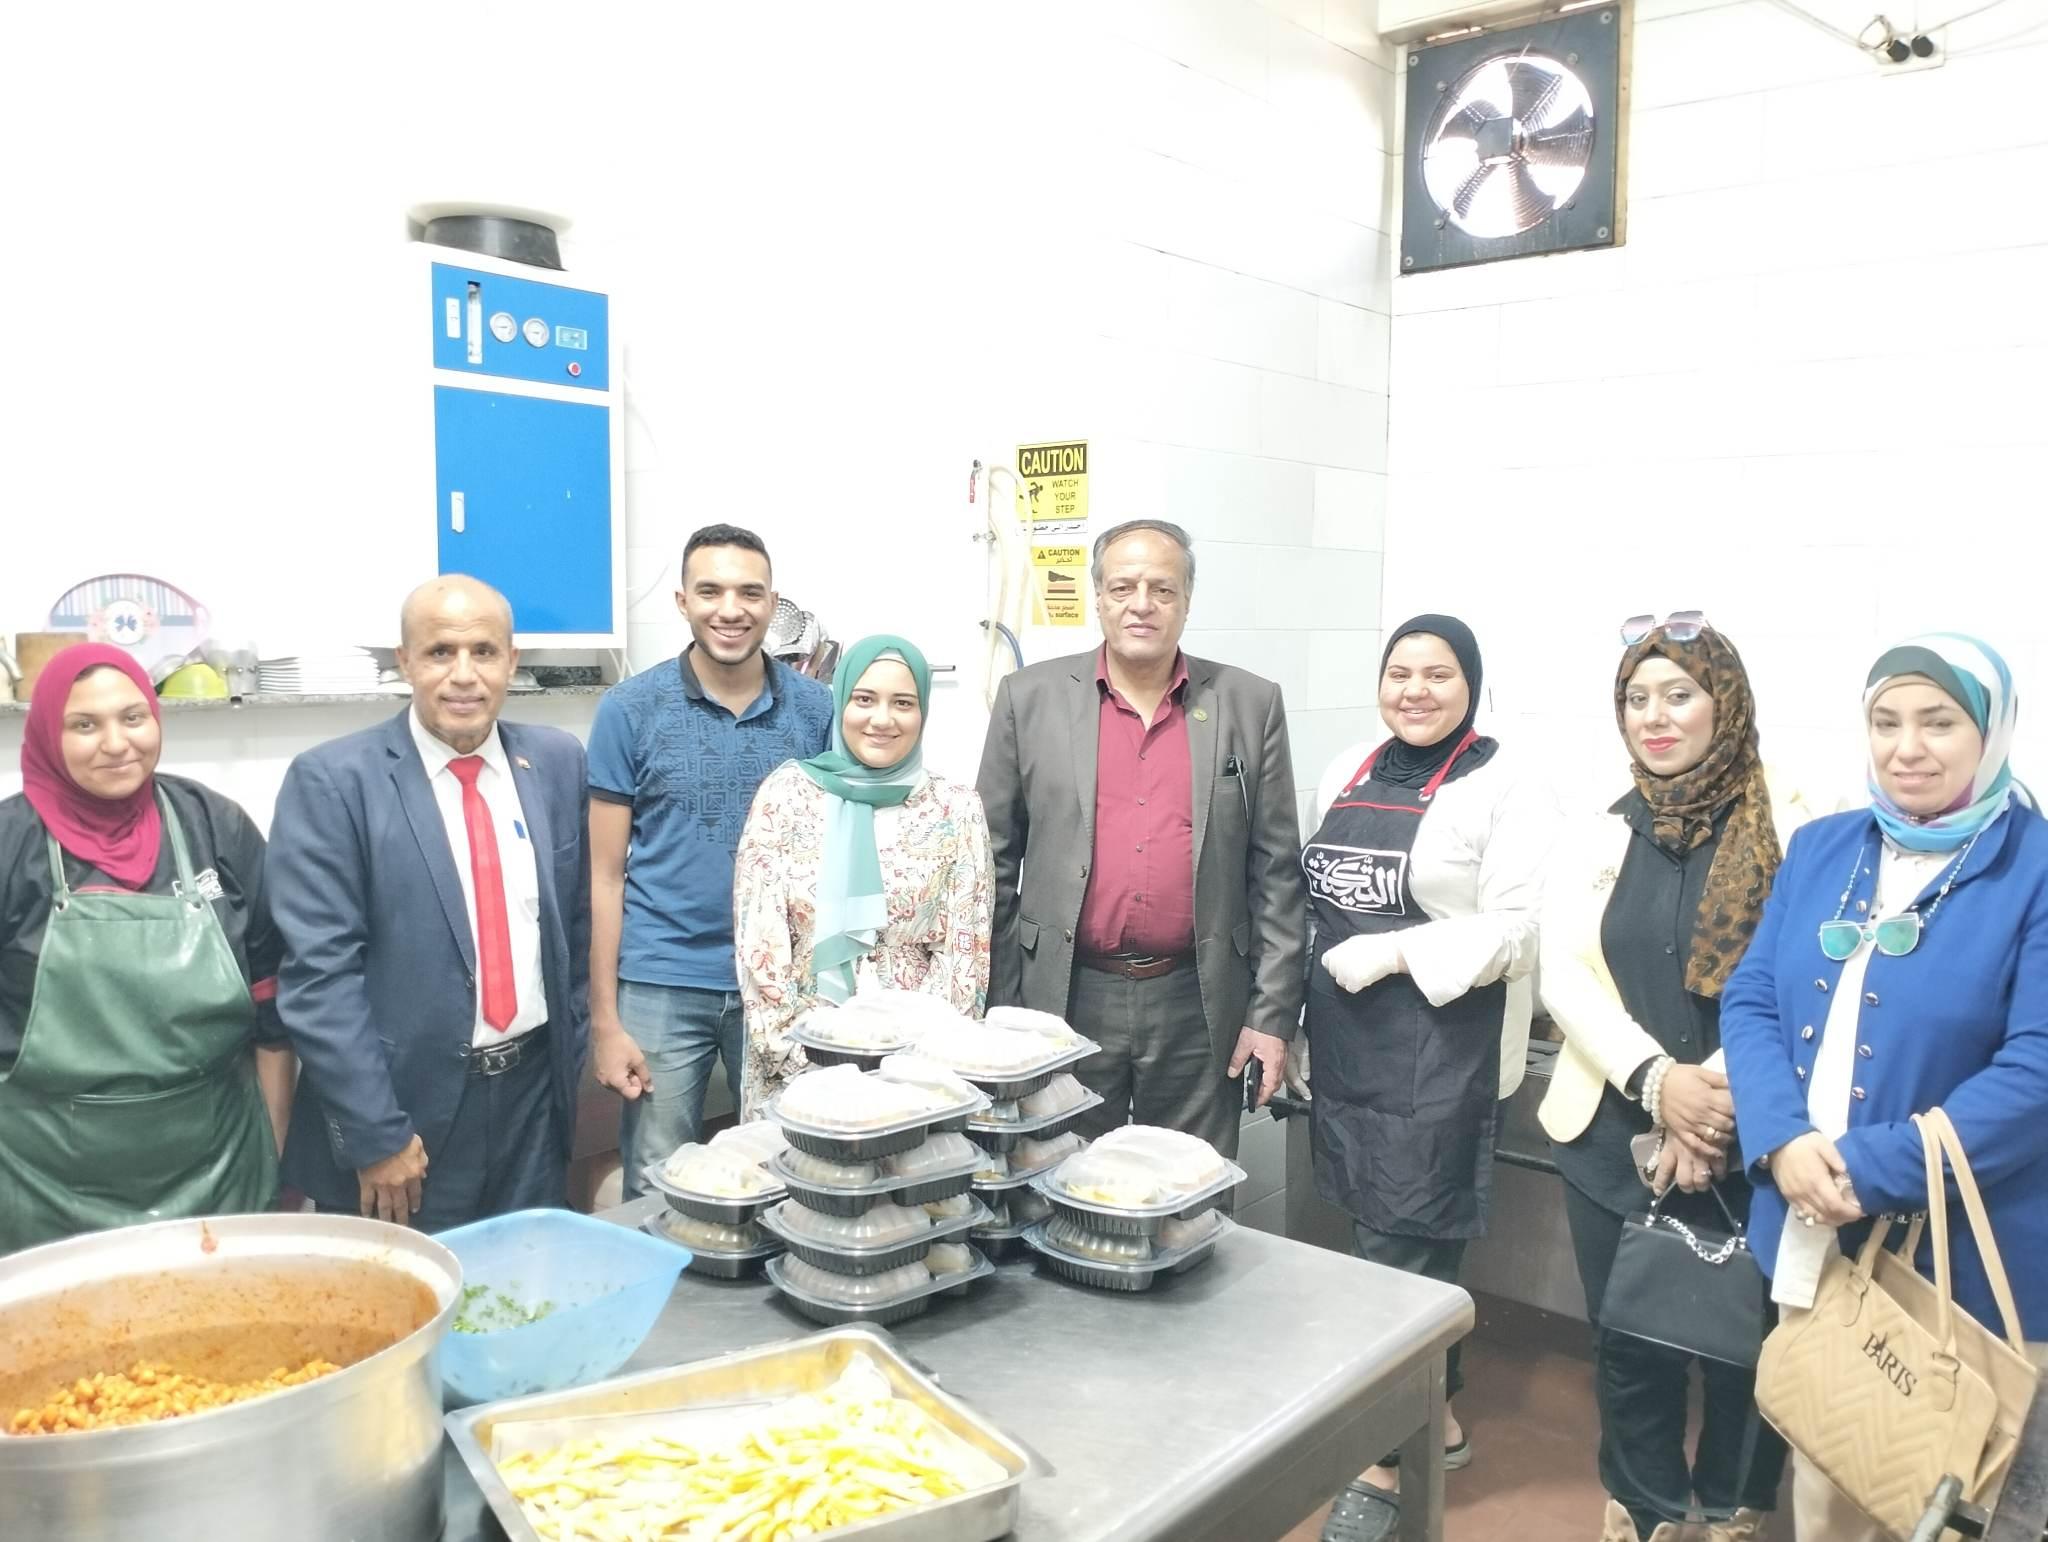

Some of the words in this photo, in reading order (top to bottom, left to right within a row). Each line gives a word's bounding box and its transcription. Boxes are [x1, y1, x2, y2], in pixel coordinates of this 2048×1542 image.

[1021, 447, 1084, 475] CAUTION
[1052, 479, 1079, 488] WATCH
[1055, 491, 1076, 501] YOUR
[1055, 504, 1076, 514] STEP
[1048, 548, 1080, 557] CAUTION
[1055, 611, 1079, 619] surface
[1861, 1330, 1918, 1397] PARIS
